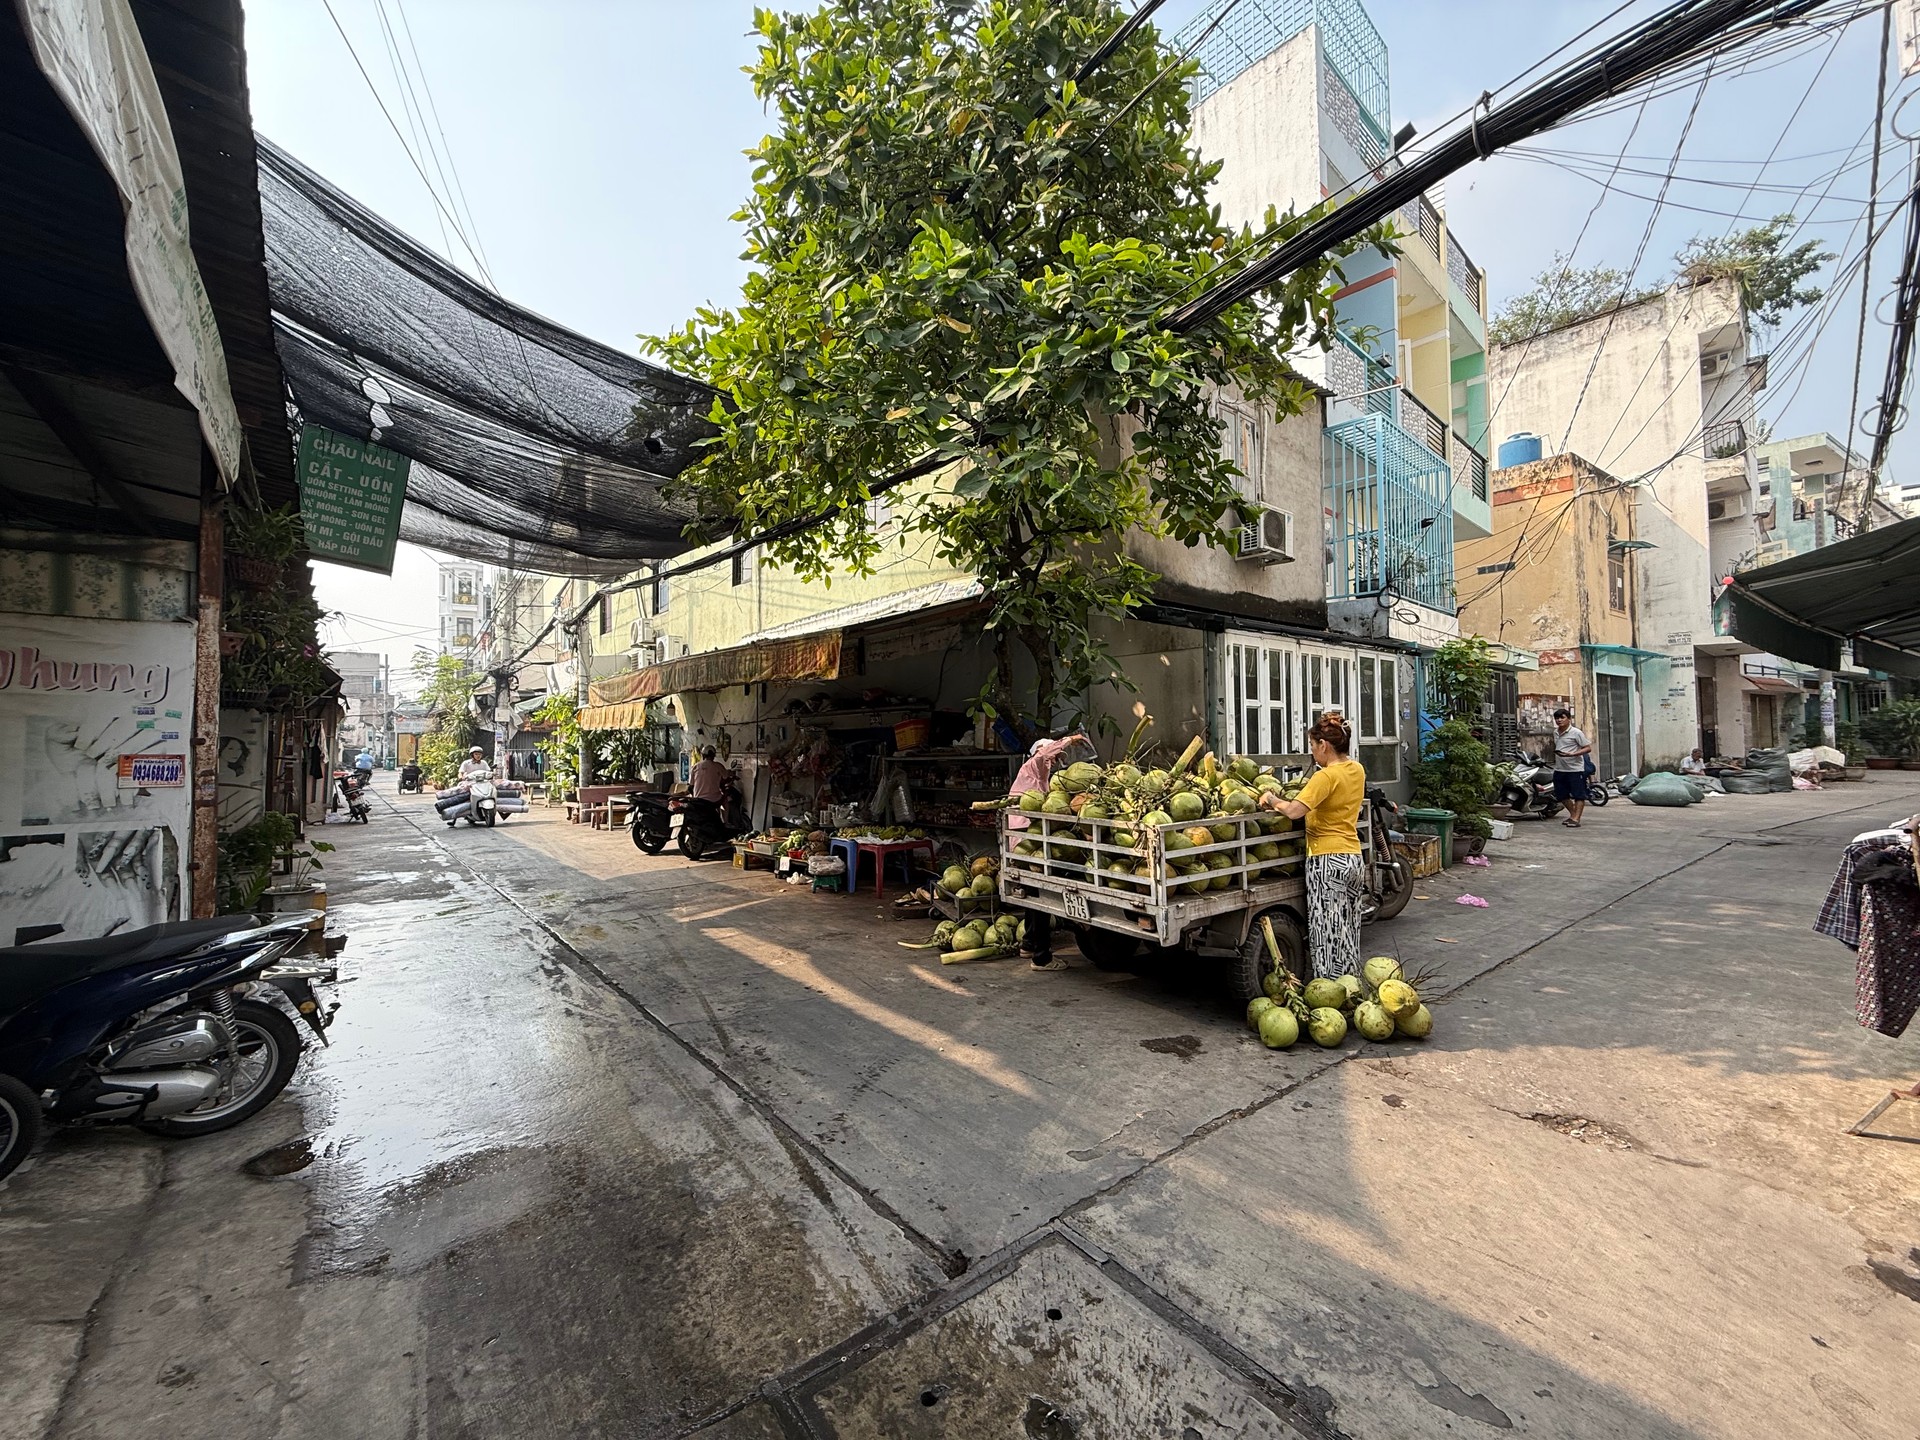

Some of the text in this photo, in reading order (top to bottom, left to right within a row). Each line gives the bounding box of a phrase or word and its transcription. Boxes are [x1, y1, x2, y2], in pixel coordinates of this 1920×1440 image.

[313, 439, 357, 459] CHÂU
[361, 452, 396, 471] NAIL
[309, 461, 393, 493] CẮT UỐN
[304, 487, 337, 501] NHUỘM
[328, 482, 363, 497] SETTING
[316, 501, 343, 515] MÓNG
[371, 514, 386, 525] GEL
[321, 514, 347, 527] MÓNG
[319, 526, 333, 536] MI
